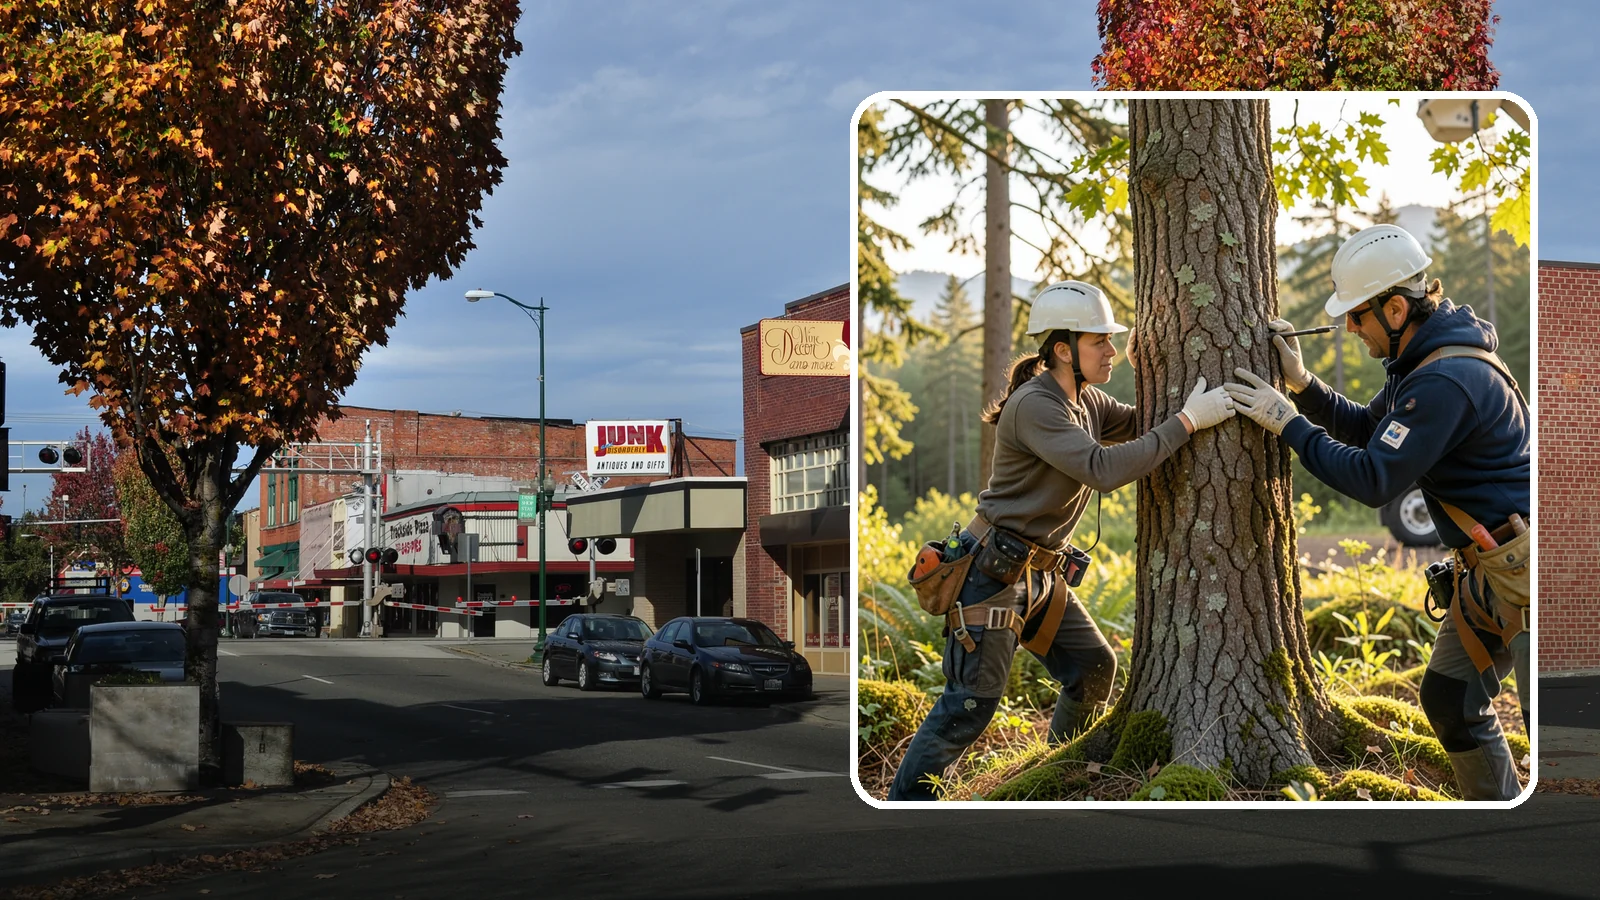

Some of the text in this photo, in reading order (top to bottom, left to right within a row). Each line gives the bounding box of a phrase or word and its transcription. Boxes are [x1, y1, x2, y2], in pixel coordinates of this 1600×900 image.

[595, 425, 665, 457] JUNK
[607, 446, 645, 454] DISORDERLY
[597, 460, 665, 470] ANTIQUES AND GIFTS
[414, 519, 429, 535] Pizza
